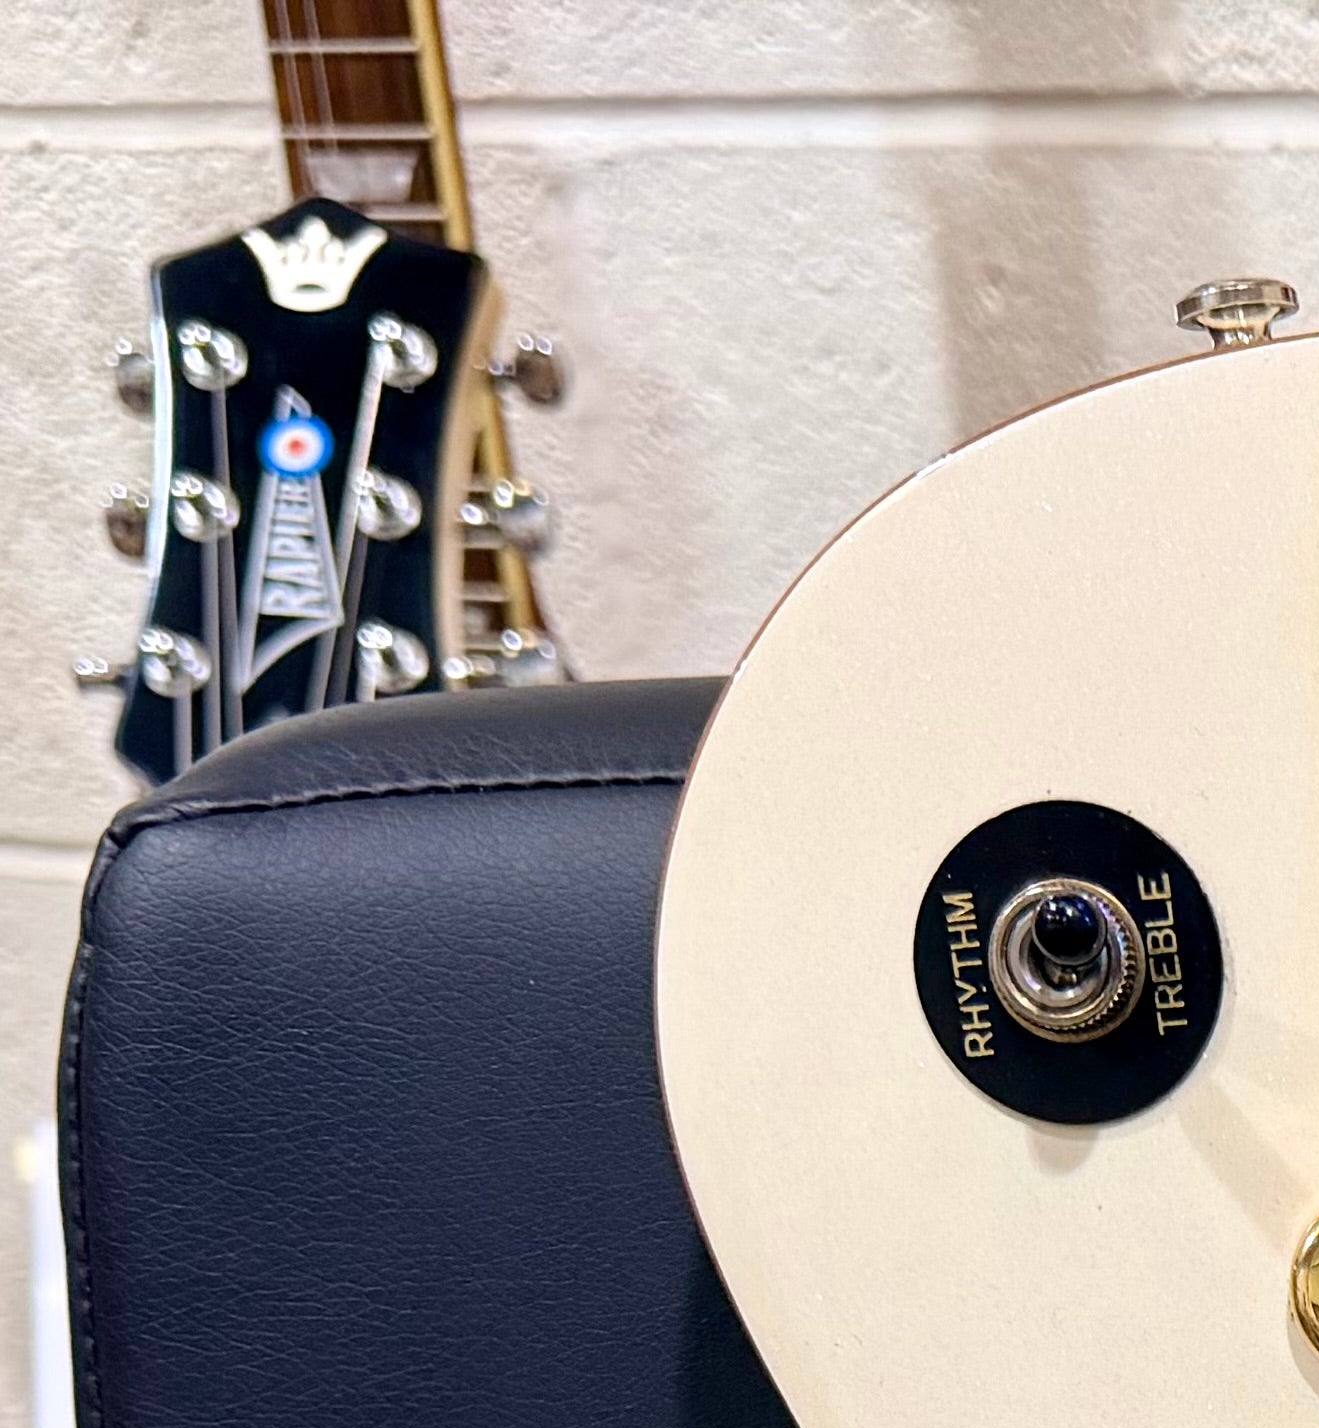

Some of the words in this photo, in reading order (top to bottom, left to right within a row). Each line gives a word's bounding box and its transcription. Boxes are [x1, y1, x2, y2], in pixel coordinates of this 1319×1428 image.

[258, 474, 336, 619] RAPIER
[943, 889, 995, 1059] RHYTHM
[1136, 870, 1189, 1037] TREBLE
